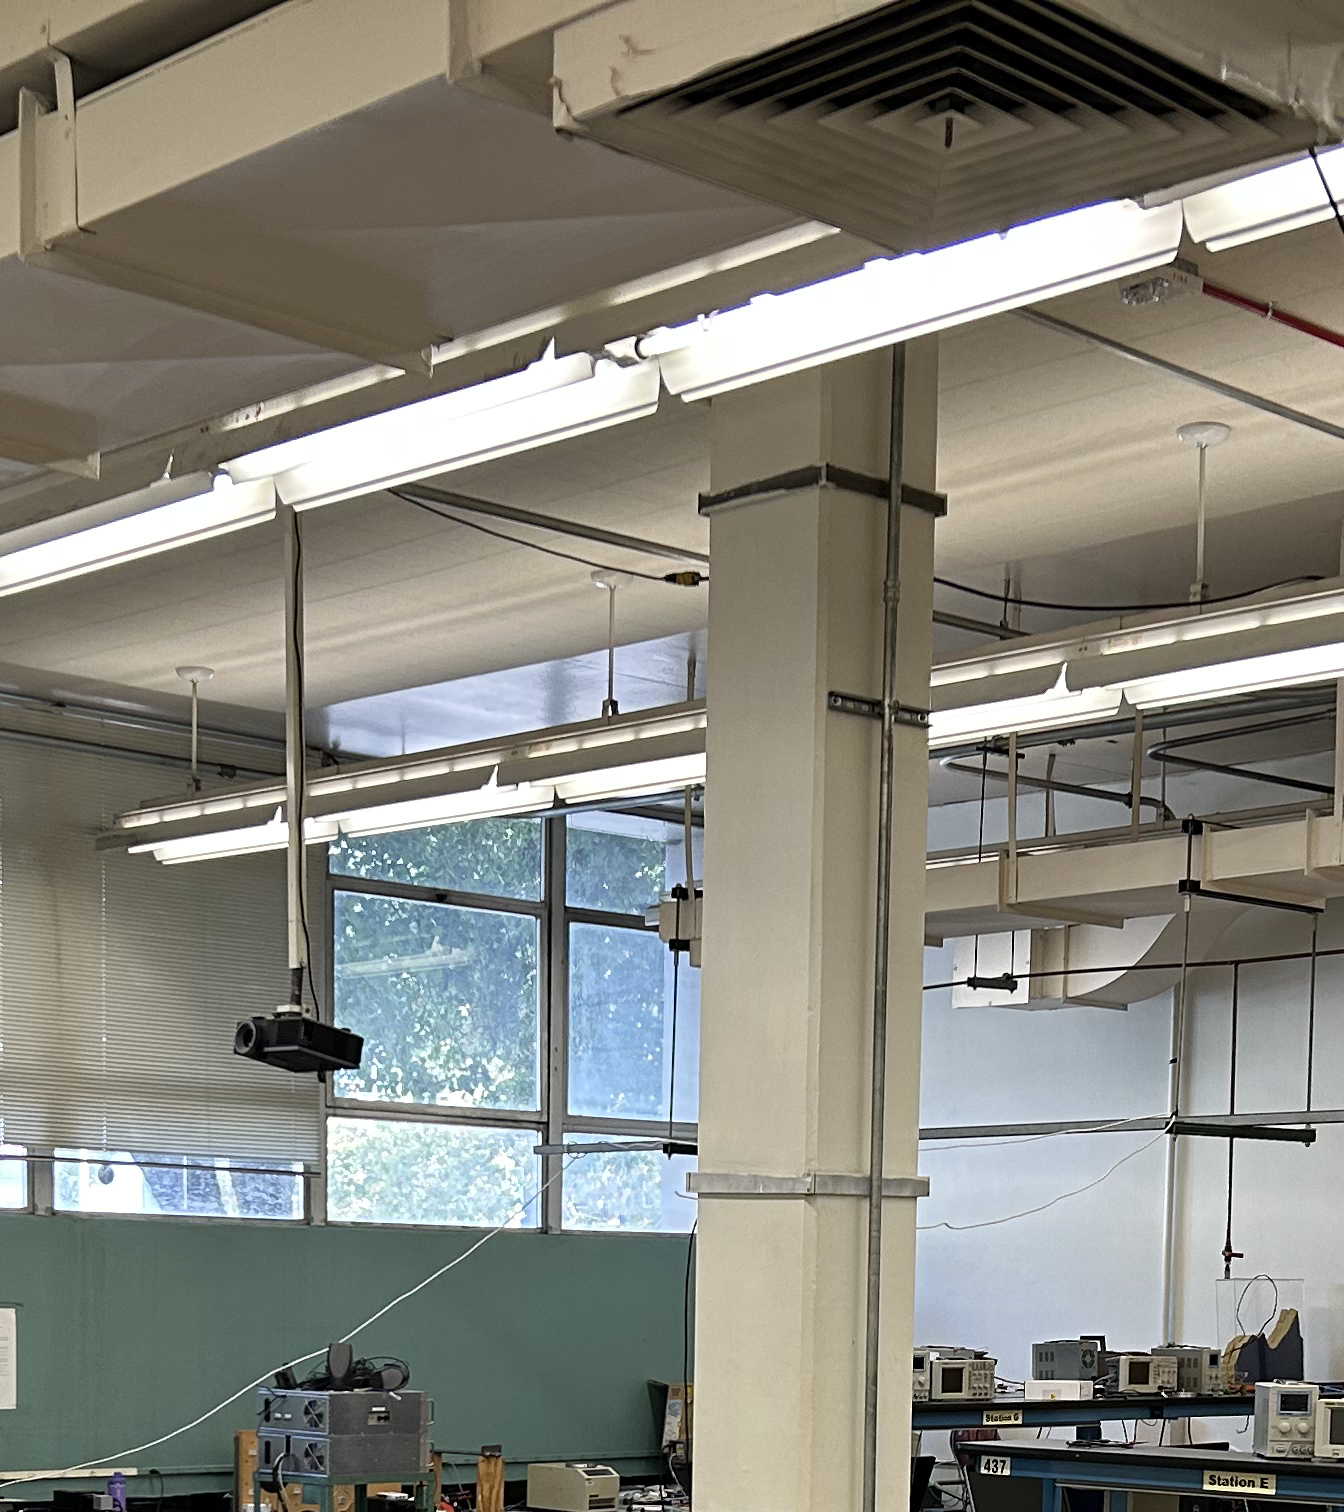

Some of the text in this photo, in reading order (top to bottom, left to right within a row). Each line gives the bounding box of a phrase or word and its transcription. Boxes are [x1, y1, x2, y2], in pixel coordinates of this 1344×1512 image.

[984, 1458, 1007, 1474] 437
[1209, 1474, 1269, 1489] Station E
